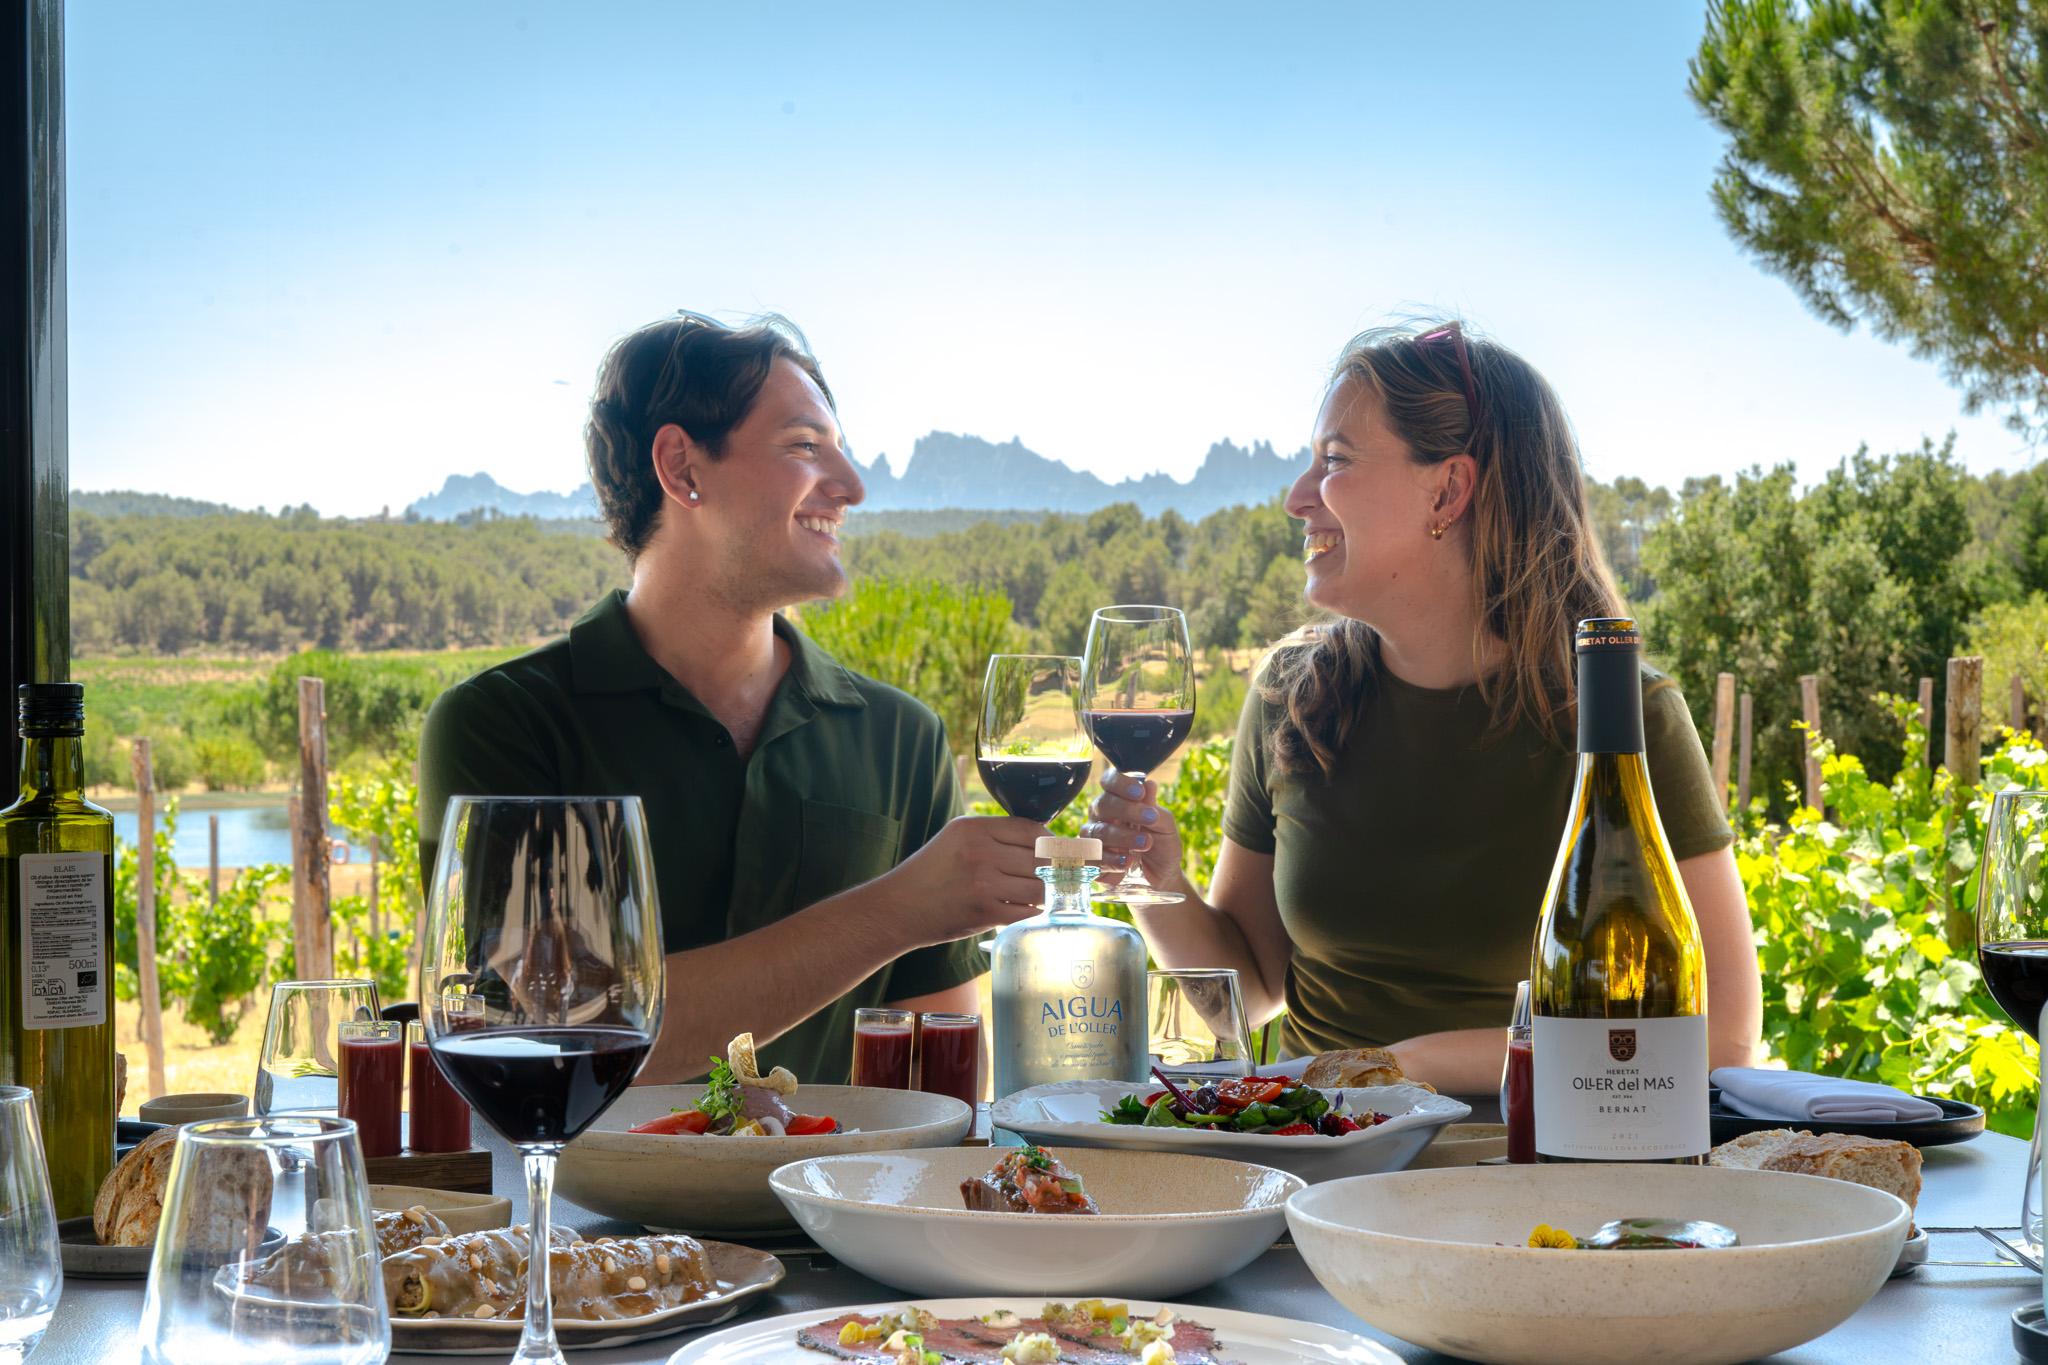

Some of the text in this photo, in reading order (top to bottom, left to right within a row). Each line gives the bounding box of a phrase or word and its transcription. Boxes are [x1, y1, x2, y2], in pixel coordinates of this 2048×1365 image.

[1608, 636, 1632, 644] OLLER
[68, 959, 97, 970] 500ml
[1041, 996, 1123, 1025] AIGUA
[1048, 1022, 1117, 1038] DE L'OLLER
[1572, 1076, 1675, 1091] OLLER del MAS
